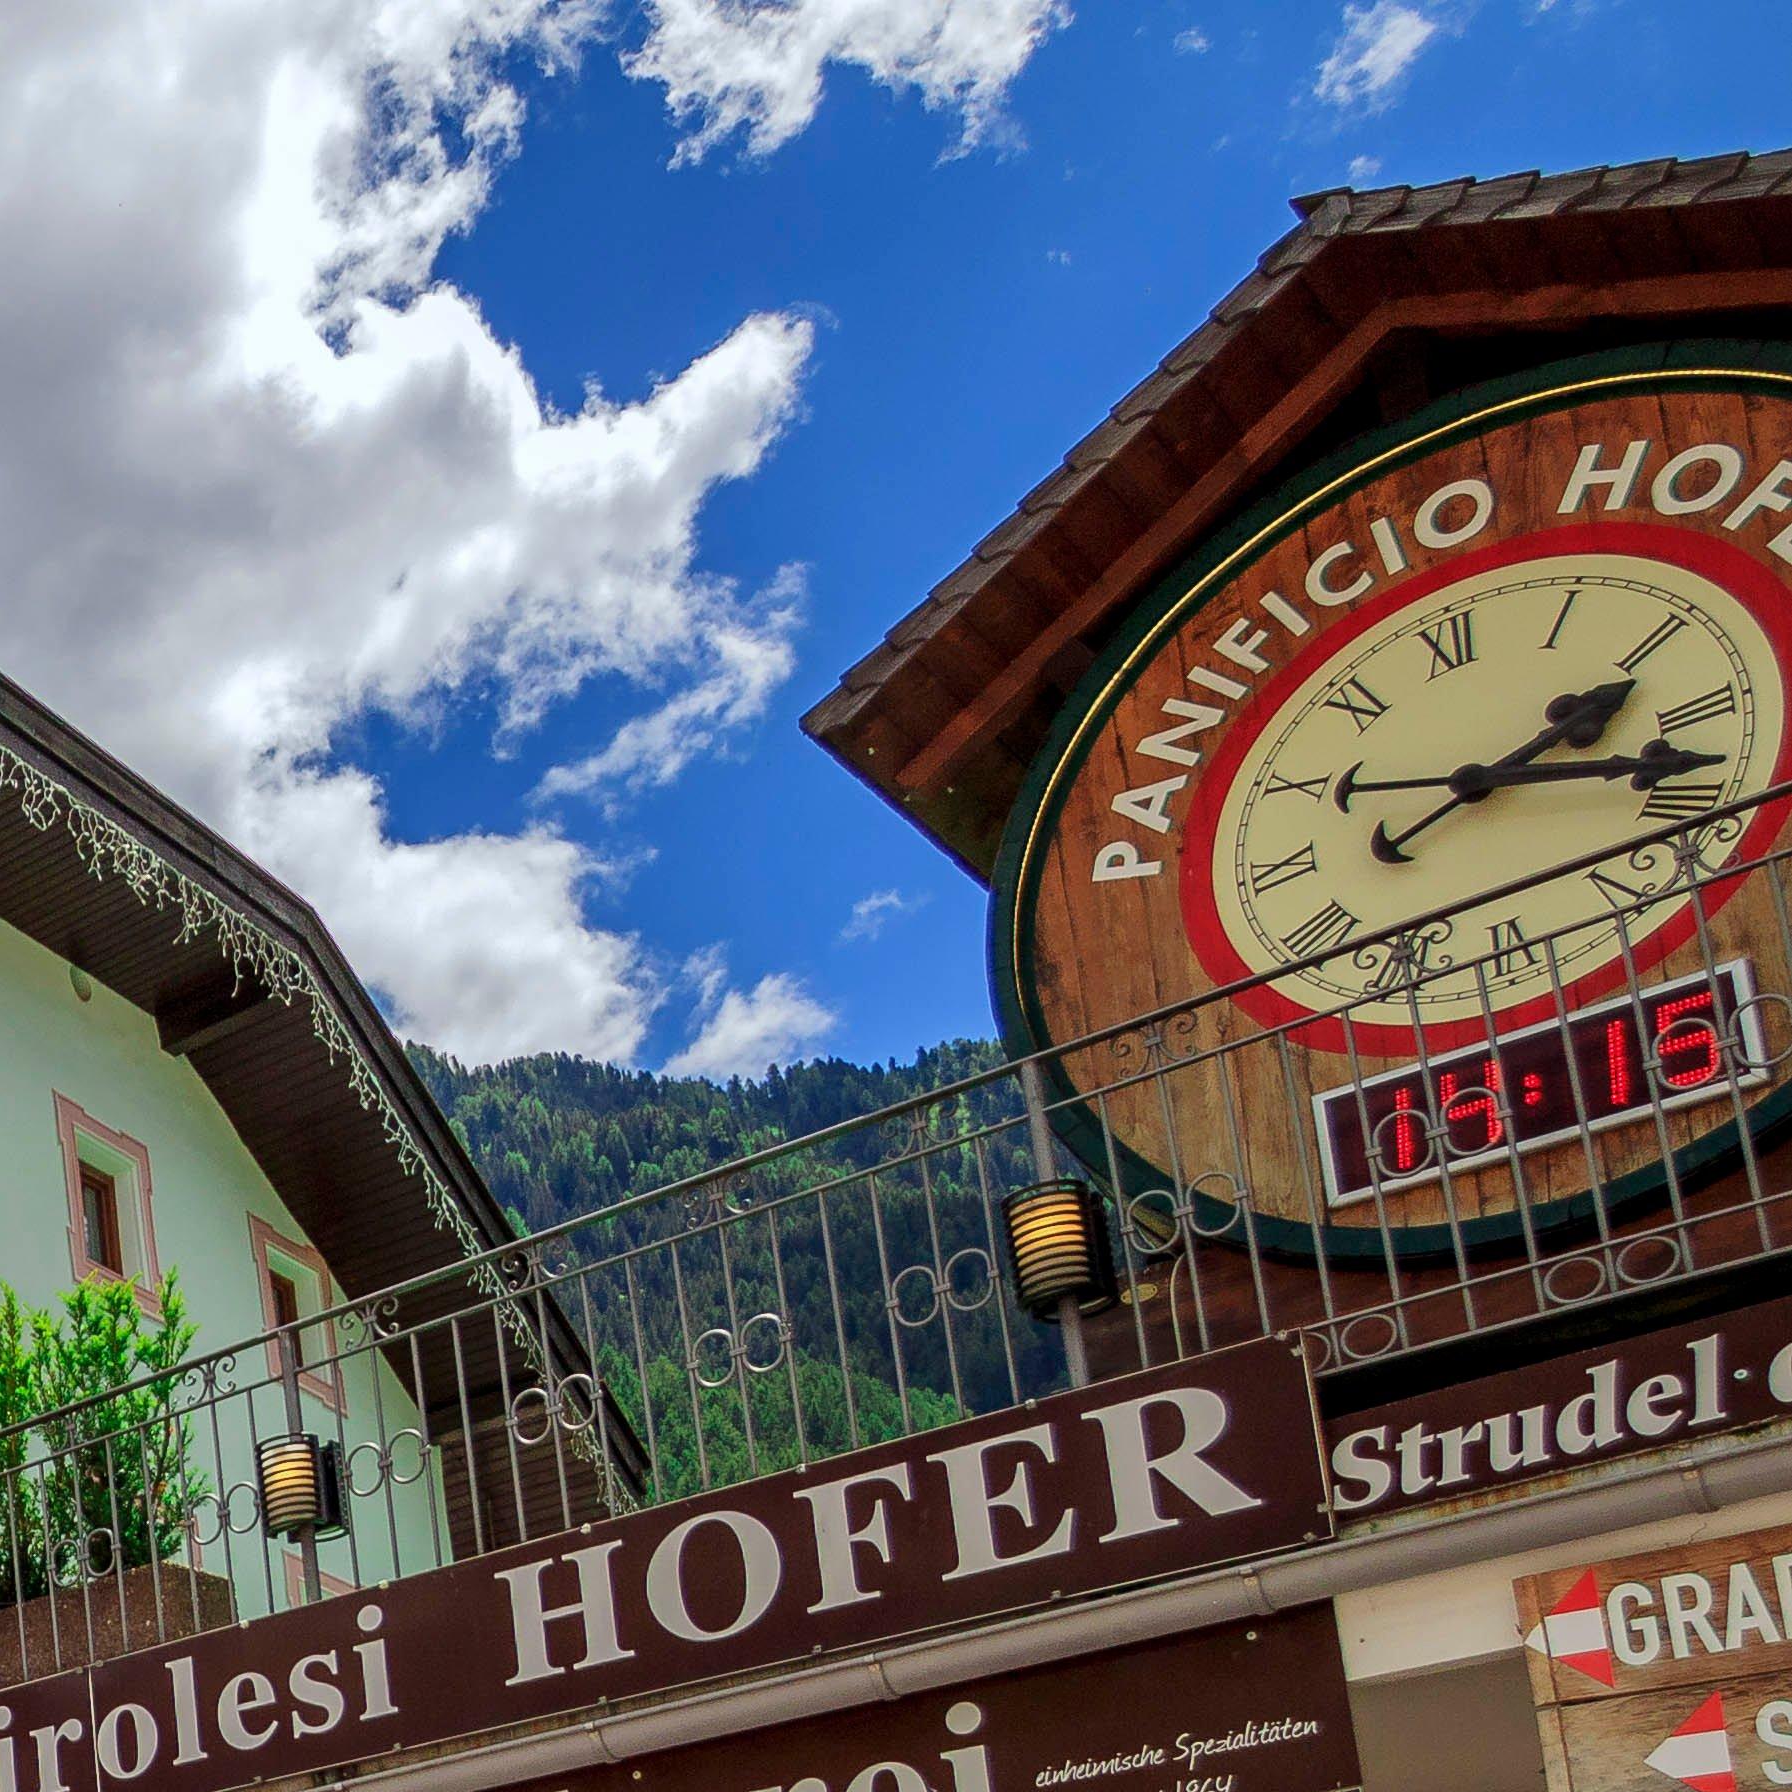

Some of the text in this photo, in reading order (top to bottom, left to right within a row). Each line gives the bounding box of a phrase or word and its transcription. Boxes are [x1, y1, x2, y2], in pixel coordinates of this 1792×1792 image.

[1092, 479, 1494, 884] PANIFICIO
[1411, 609, 1479, 682] XII
[1321, 675, 1393, 736] XI
[1260, 770, 1333, 804] X
[1252, 840, 1318, 897] IX
[1395, 992, 1718, 1169] 14:15
[1332, 1334, 1727, 1511] Strudel
[494, 1386, 1263, 1689] HOFER
[1036, 1717, 1319, 1788] einheimische Spezialitäten
